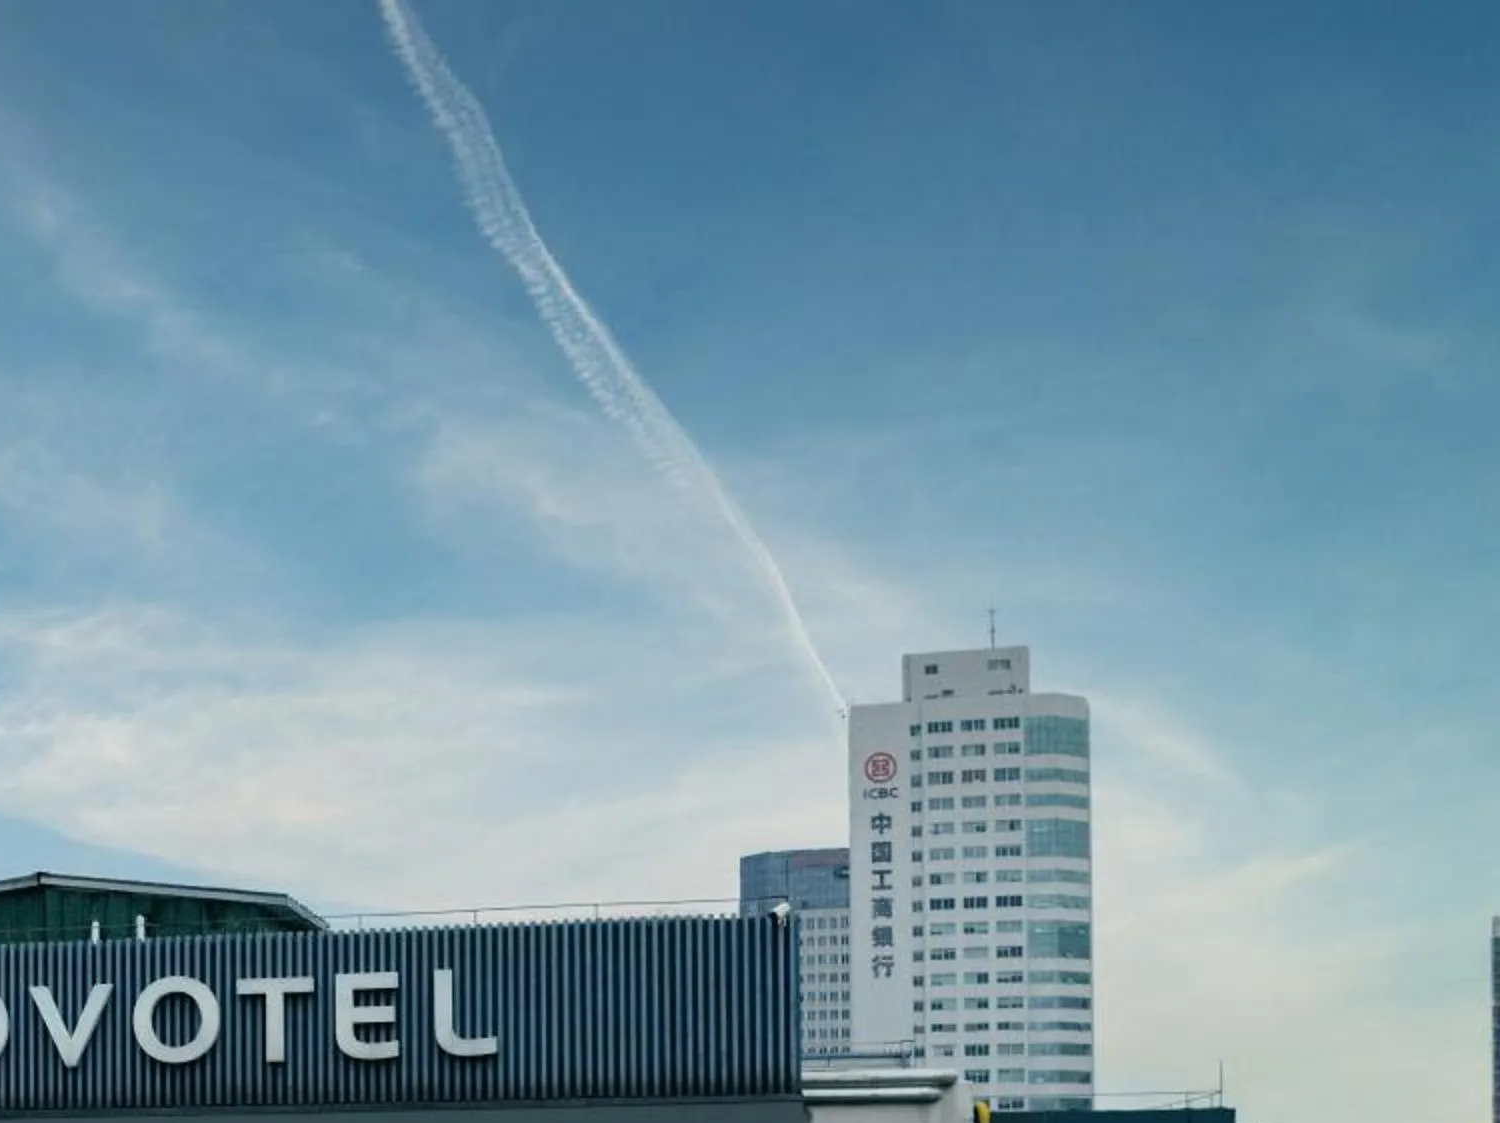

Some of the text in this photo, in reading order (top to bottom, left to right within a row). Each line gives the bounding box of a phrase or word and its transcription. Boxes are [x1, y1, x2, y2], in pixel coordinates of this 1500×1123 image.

[863, 787, 899, 800] ICBC
[871, 811, 895, 978] 中国工商银行
